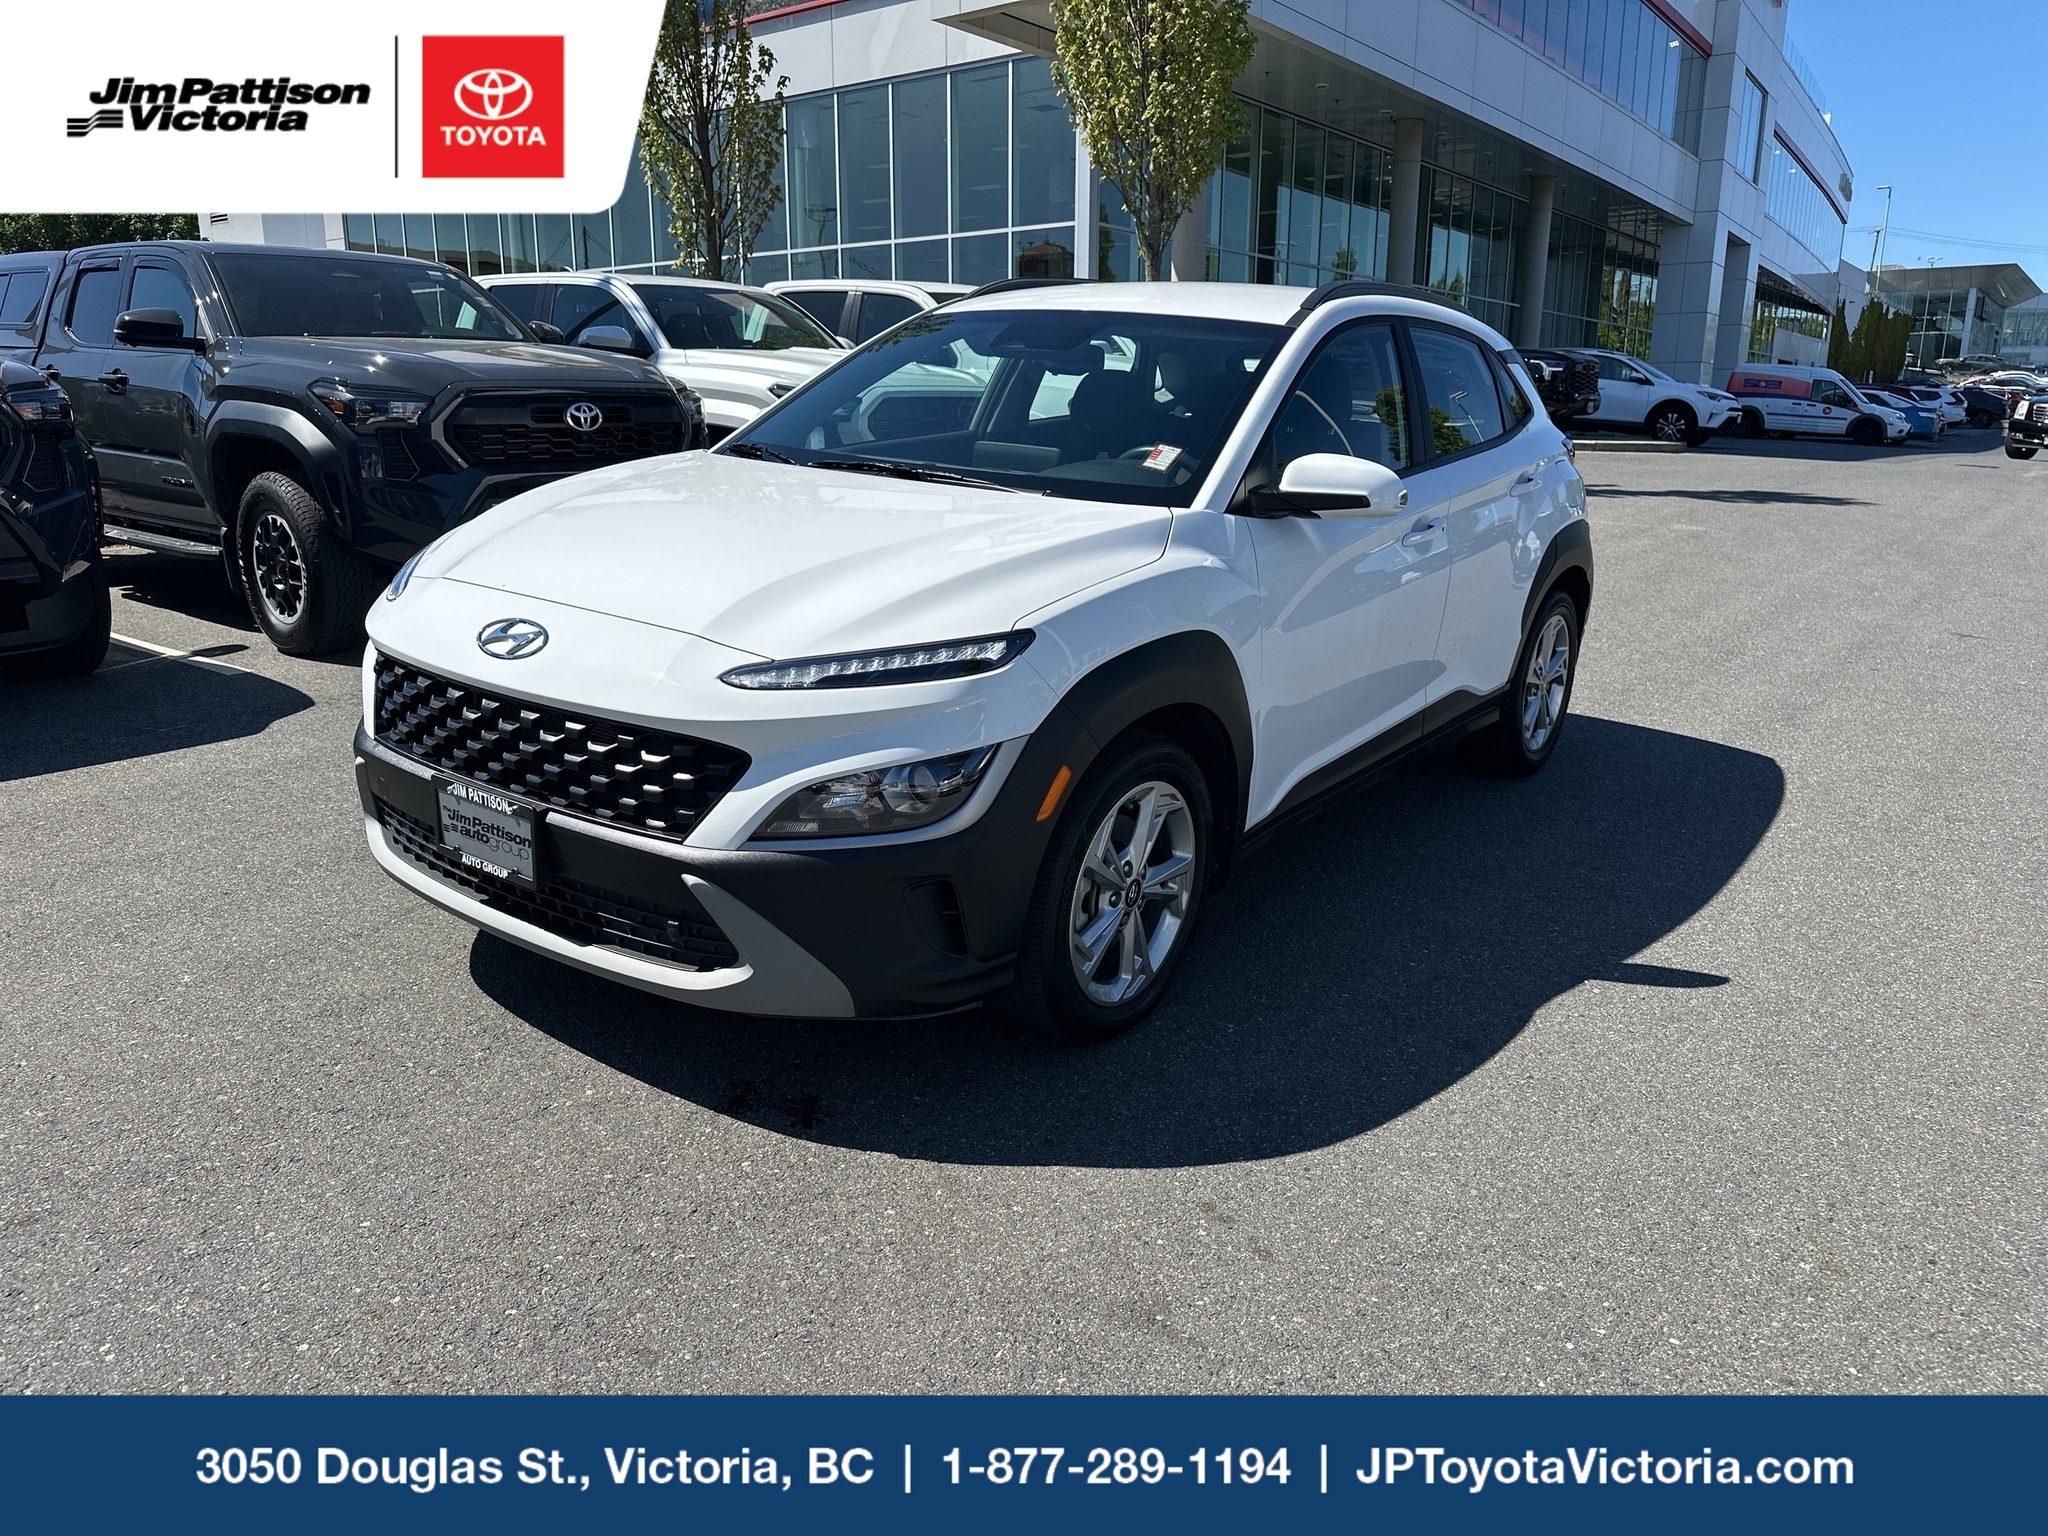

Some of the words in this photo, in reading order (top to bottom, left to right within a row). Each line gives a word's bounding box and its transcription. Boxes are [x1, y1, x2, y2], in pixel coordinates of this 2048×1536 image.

[453, 783, 467, 799] JIM
[468, 788, 509, 813] PATTISON
[461, 853, 482, 869] AUTO
[482, 862, 508, 879] GROUP
